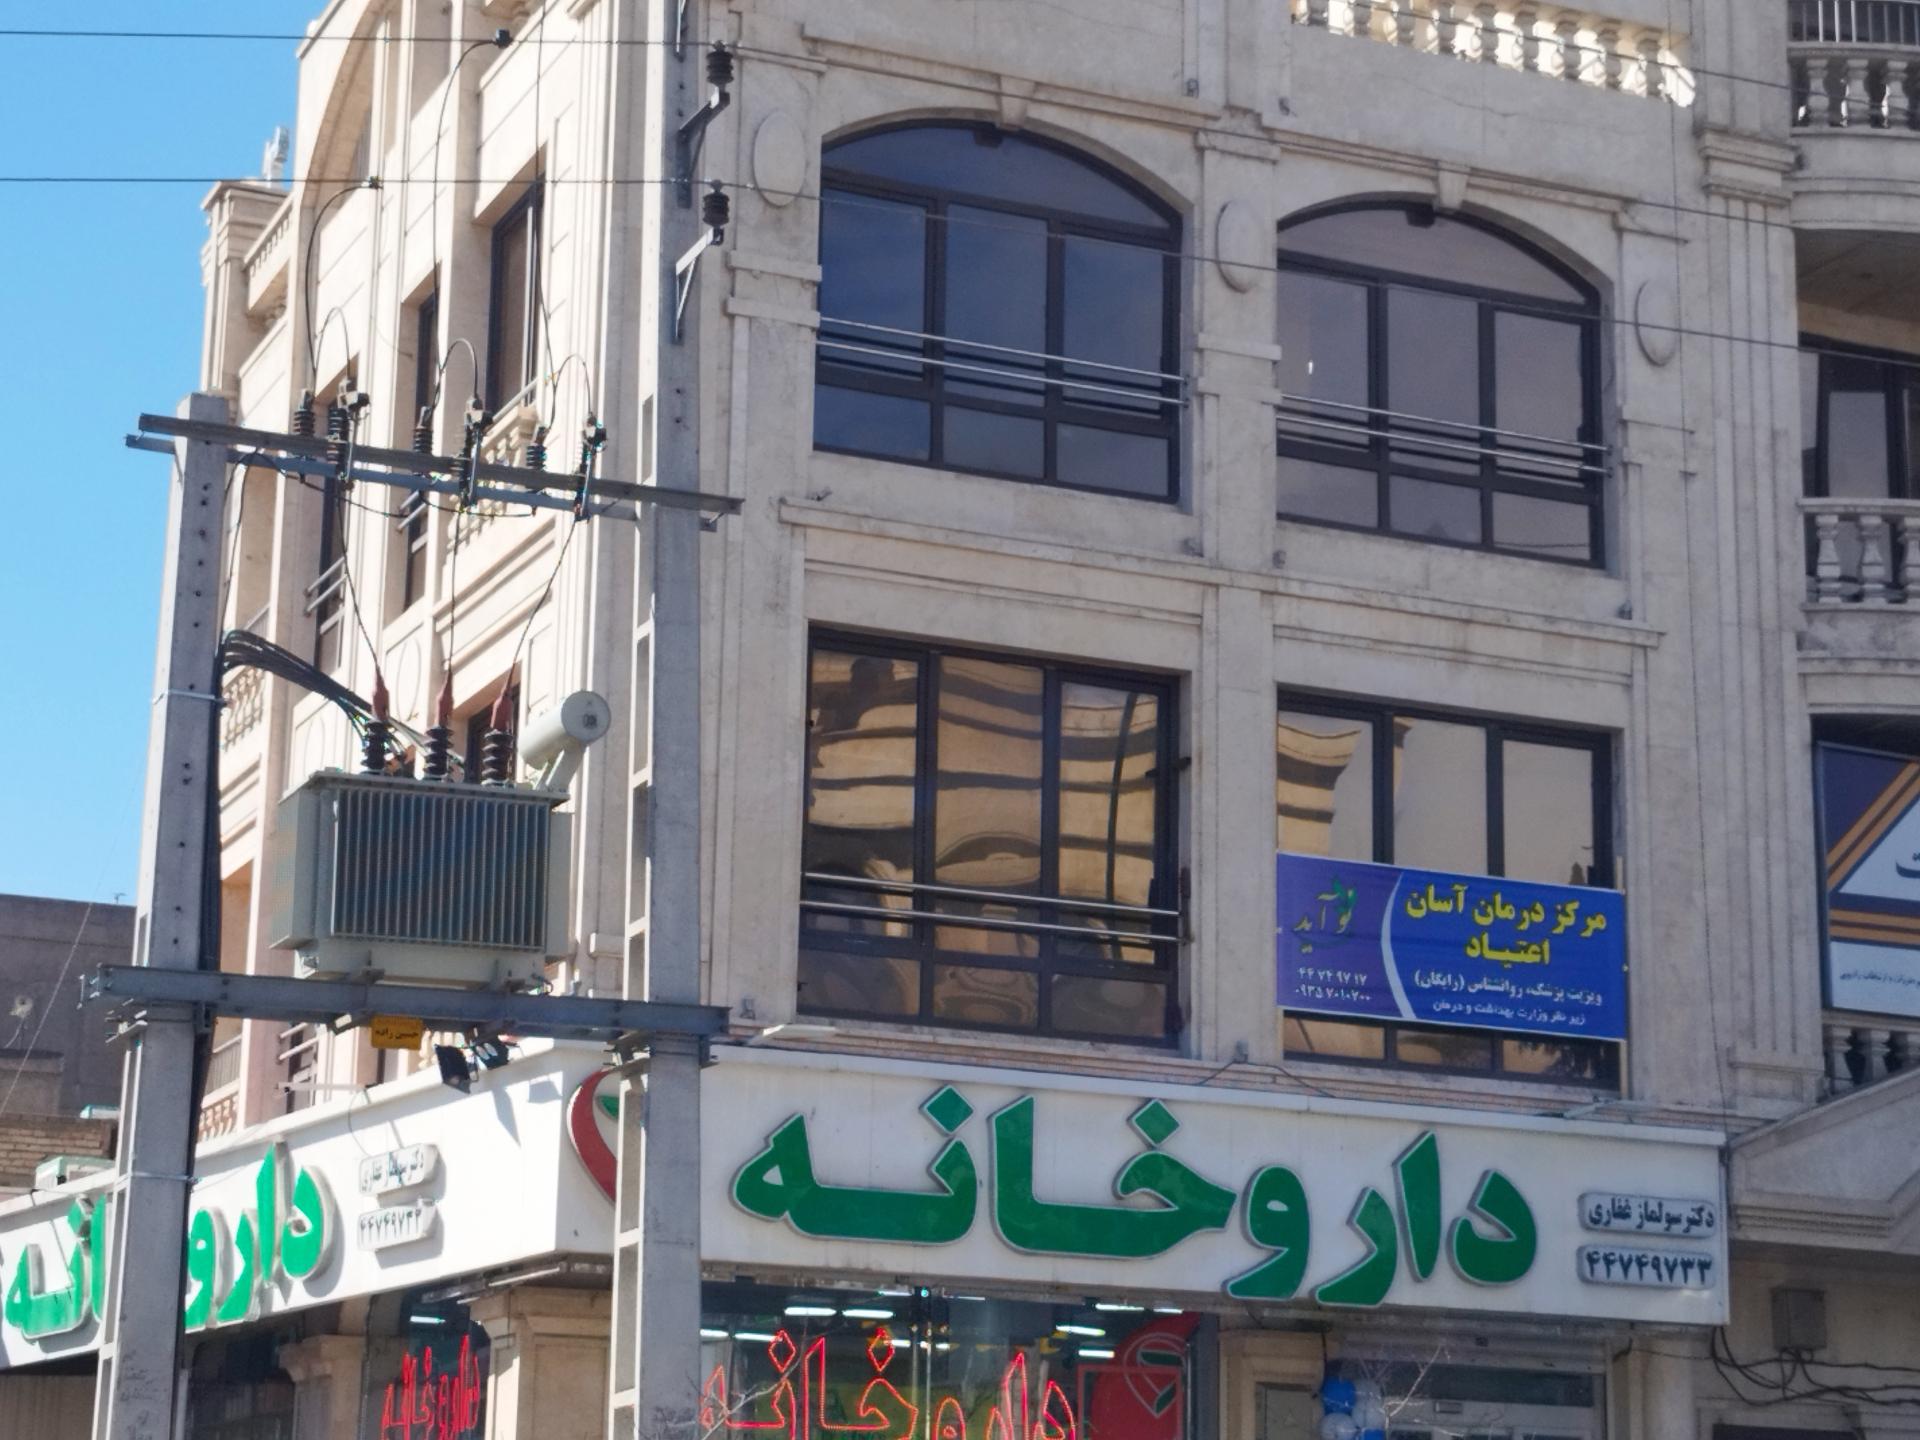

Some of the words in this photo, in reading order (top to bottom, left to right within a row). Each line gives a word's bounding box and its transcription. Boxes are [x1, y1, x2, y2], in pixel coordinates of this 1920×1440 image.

[1406, 883, 1468, 918] آسان
[1473, 891, 1546, 930] درمان
[1552, 899, 1607, 937] مرکز
[1465, 932, 1551, 968] اعتیاد
[732, 1083, 1537, 1306] داروخانه
[1588, 1198, 1633, 1226] غفاری
[1683, 1205, 1715, 1233] دکتر
[1586, 1250, 1713, 1285] ۴۴۷۴۹۷۳۳
